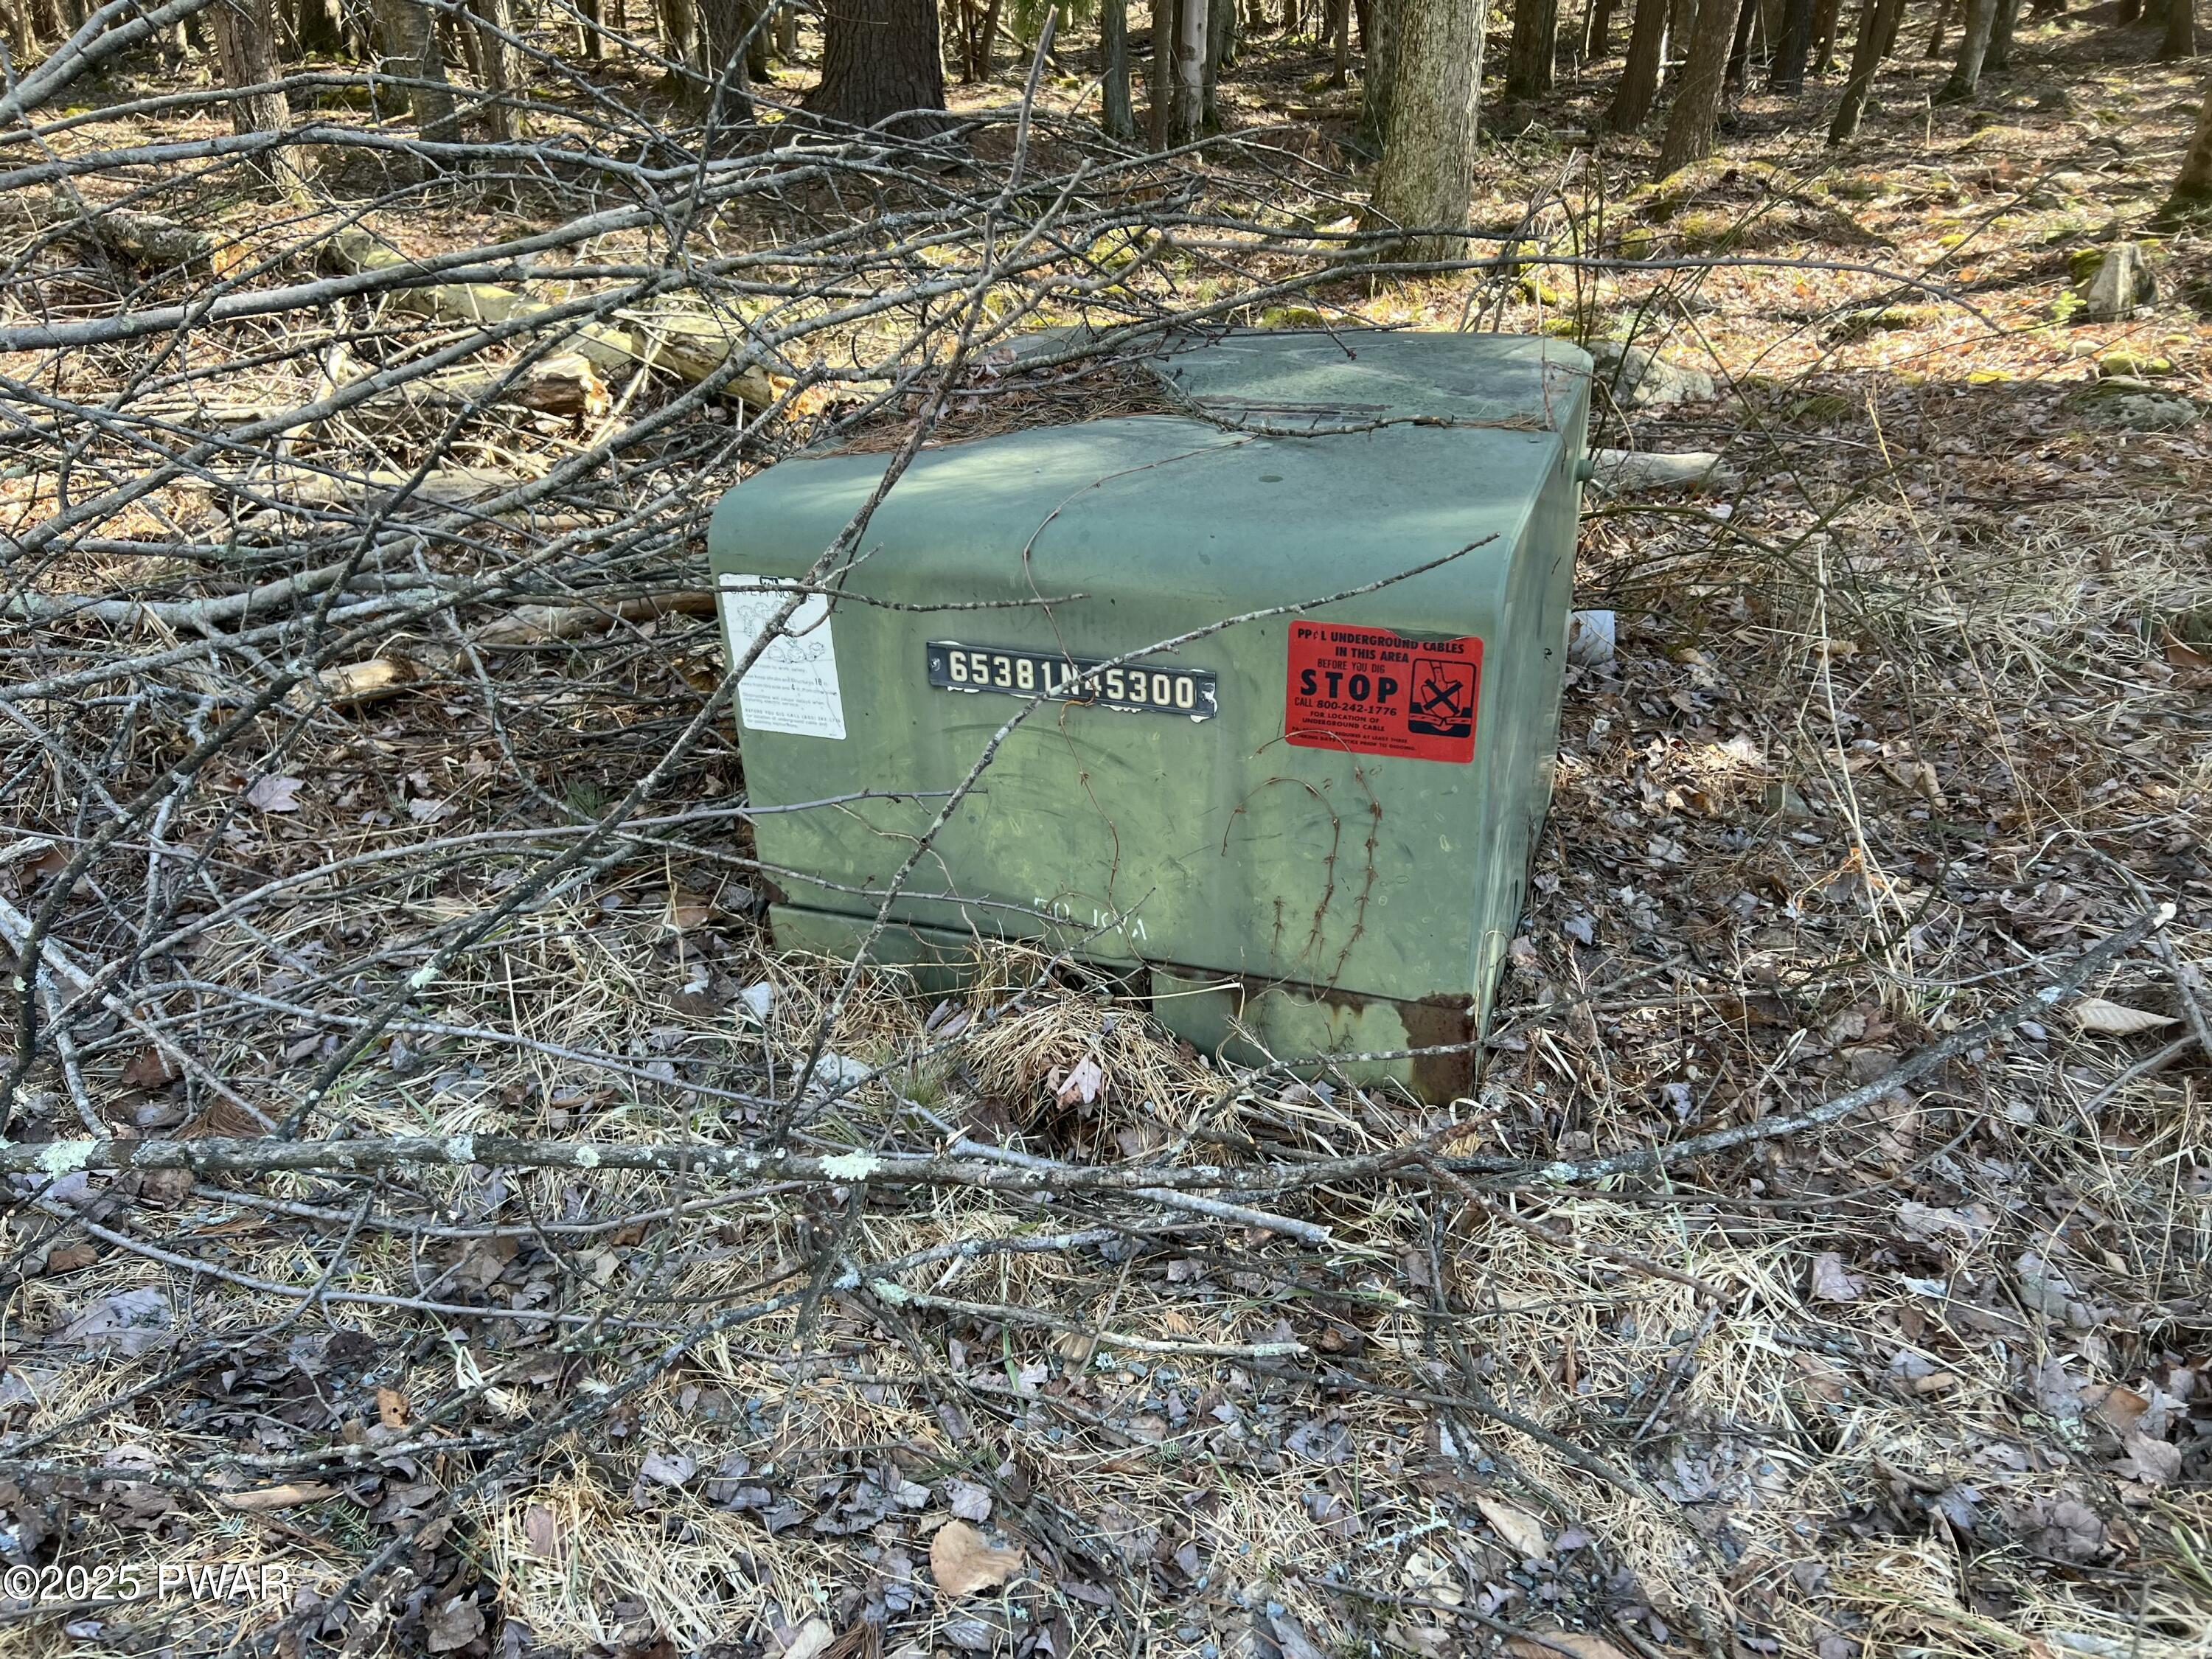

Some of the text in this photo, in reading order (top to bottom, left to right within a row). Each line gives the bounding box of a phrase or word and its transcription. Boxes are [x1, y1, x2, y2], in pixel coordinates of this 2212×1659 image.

[1330, 631, 1419, 649] UNDERGROUND
[1423, 641, 1464, 654] CABLES
[1335, 647, 1409, 663] IN THIS AREA
[1318, 658, 1385, 673] BEFORE YOU DIG
[1300, 669, 1398, 703] STOP
[1295, 697, 1397, 716] CALL 800-242-1776
[1302, 717, 1360, 728] UNDERGROUND
[1328, 713, 1366, 722] LOCATION
